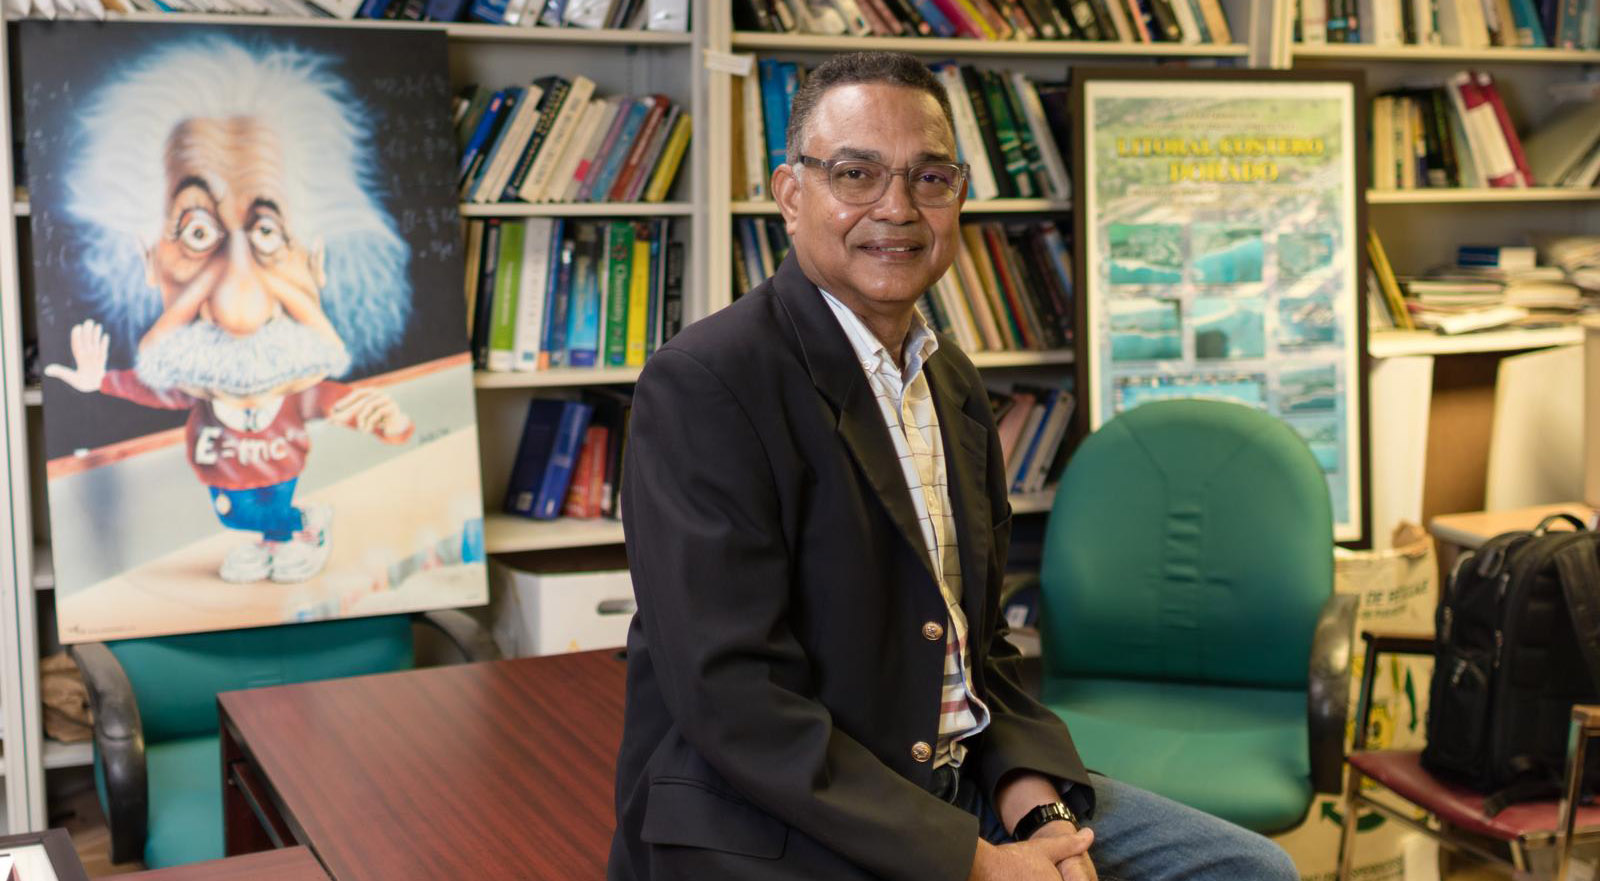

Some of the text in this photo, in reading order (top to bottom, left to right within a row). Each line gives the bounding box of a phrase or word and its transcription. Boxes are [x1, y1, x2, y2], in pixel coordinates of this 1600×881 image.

[1115, 136, 1325, 157] LITORAL COSTERO
[1169, 161, 1279, 182] DORADO
